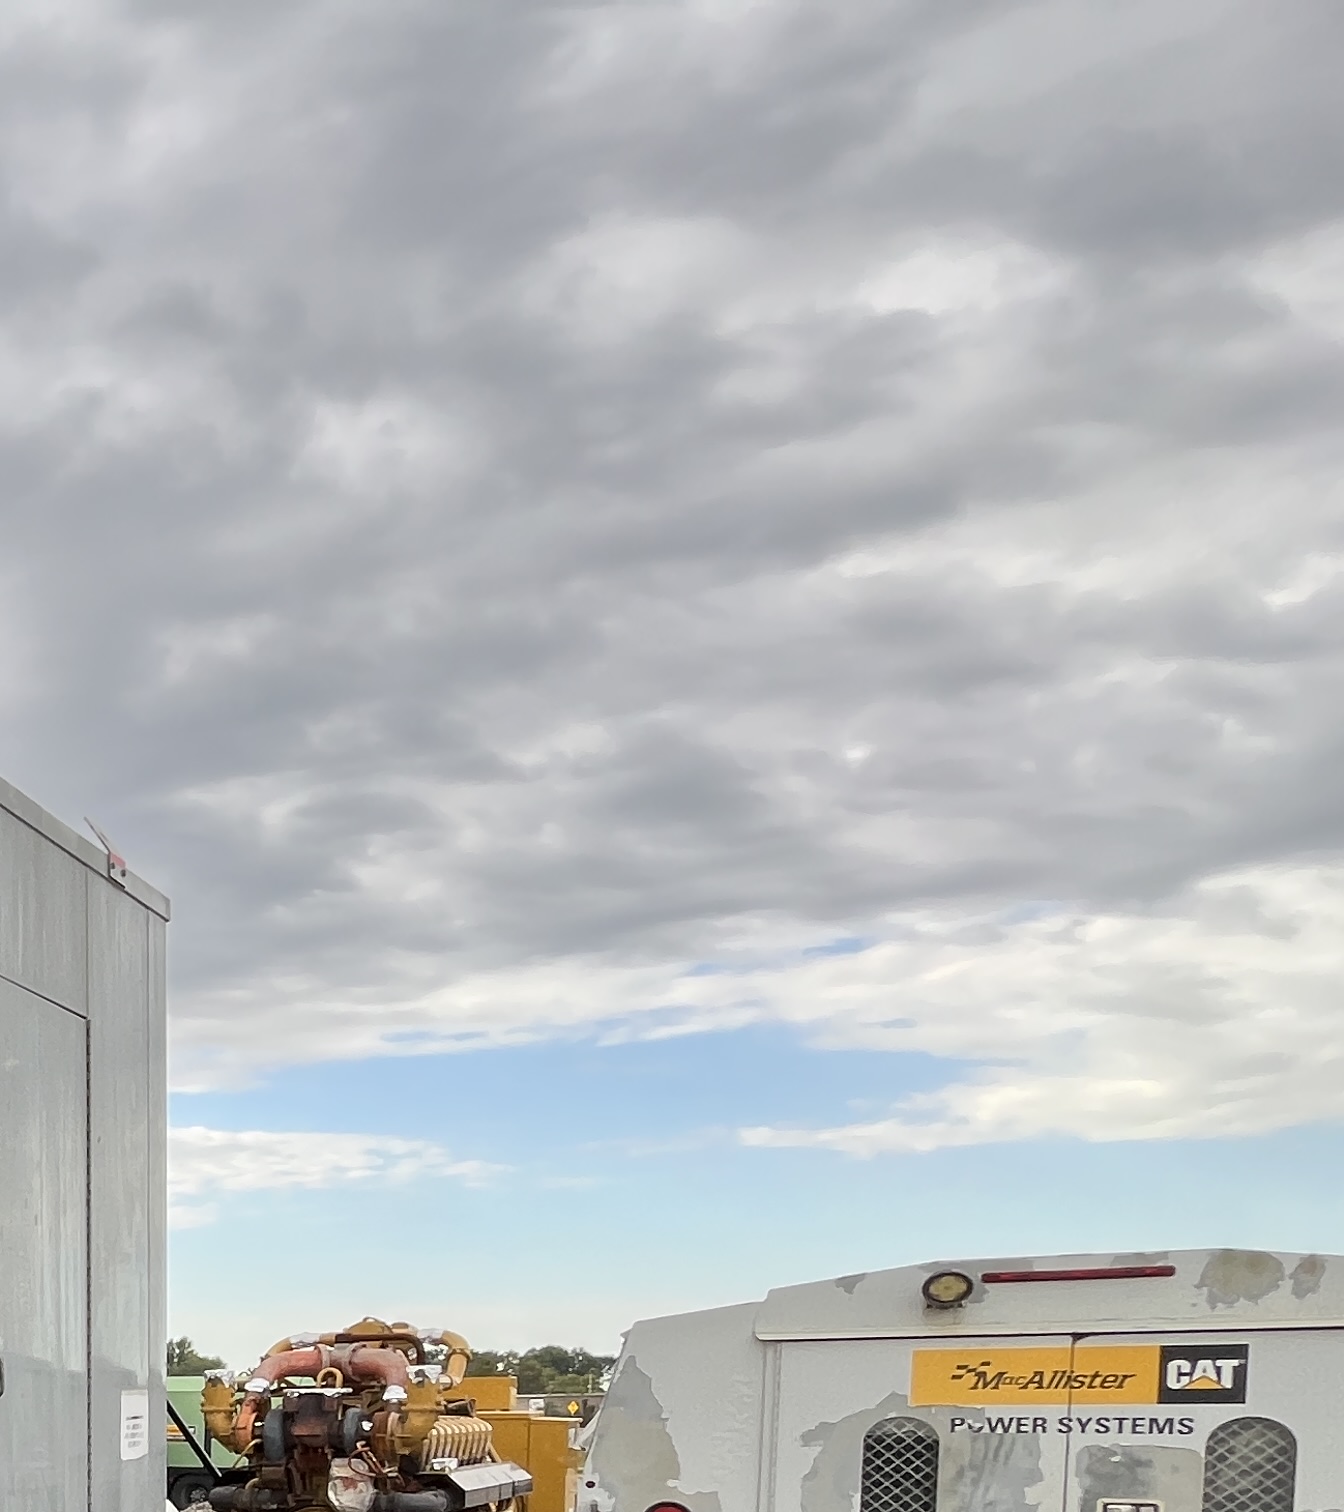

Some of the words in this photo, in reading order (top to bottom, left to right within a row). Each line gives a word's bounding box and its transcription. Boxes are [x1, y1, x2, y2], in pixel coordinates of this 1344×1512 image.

[968, 1369, 1137, 1390] MacAllister
[1165, 1358, 1241, 1391] CAT
[1056, 1416, 1195, 1435] SYSTEMS
